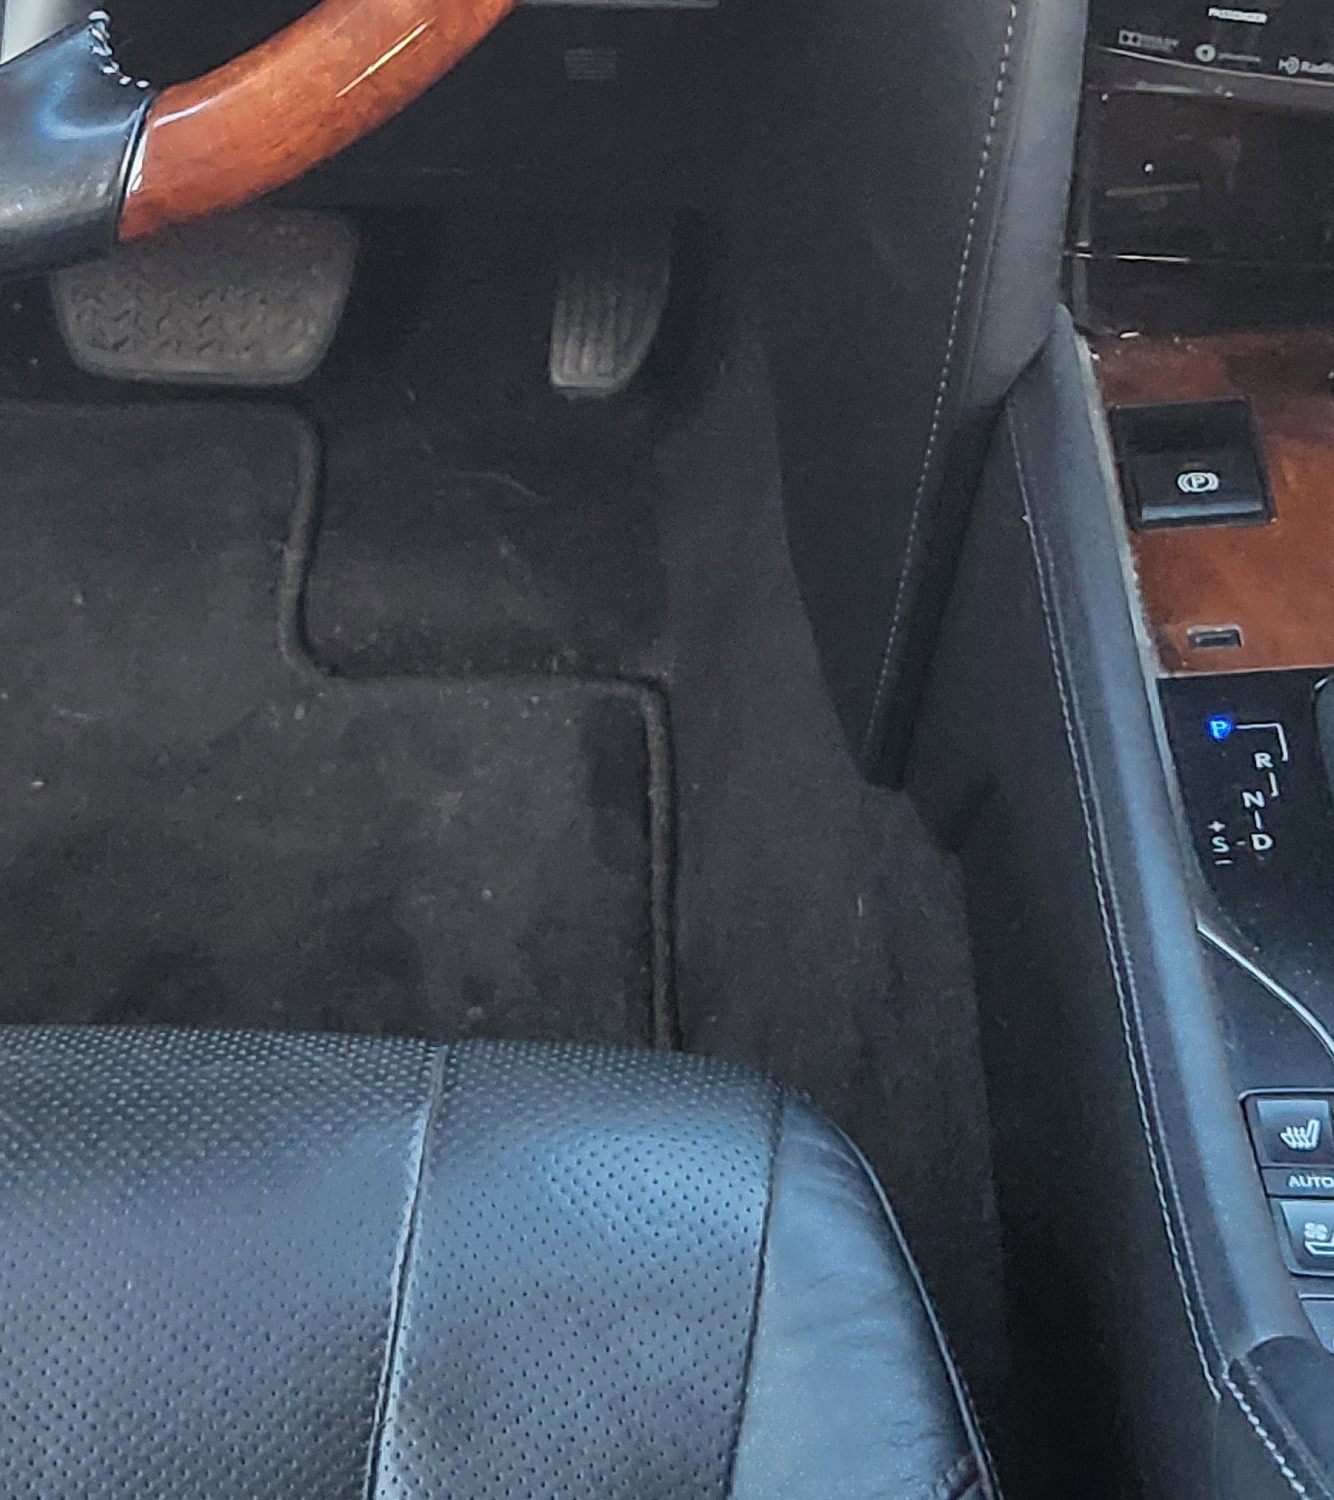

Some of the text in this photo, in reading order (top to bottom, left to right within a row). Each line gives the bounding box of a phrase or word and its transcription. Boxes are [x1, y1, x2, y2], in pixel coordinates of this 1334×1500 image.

[1210, 720, 1228, 739] P
[1254, 752, 1273, 768] R
[1242, 791, 1265, 807] N
[1212, 833, 1273, 852] S D
